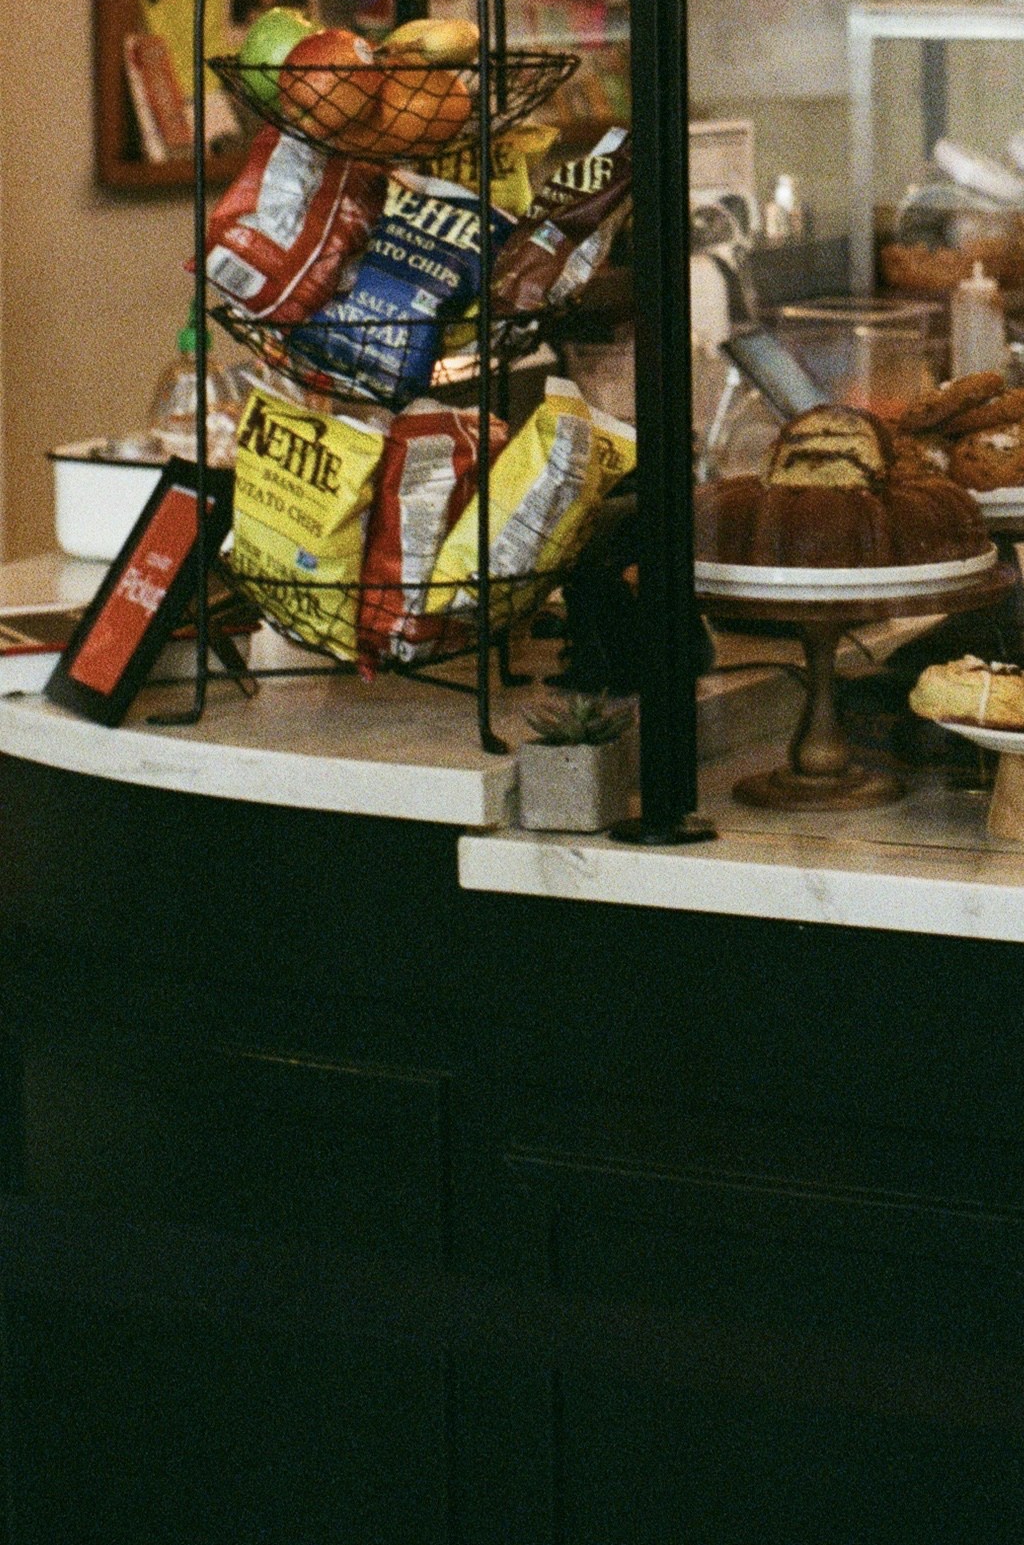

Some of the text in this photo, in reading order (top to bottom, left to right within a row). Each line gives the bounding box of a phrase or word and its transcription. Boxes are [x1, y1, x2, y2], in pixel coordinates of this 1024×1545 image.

[386, 222, 436, 251] BRAND
[371, 238, 460, 287] ATO CHIPS
[238, 395, 342, 496] KETTLE
[236, 477, 284, 513] OTATO
[263, 467, 303, 499] BRAND
